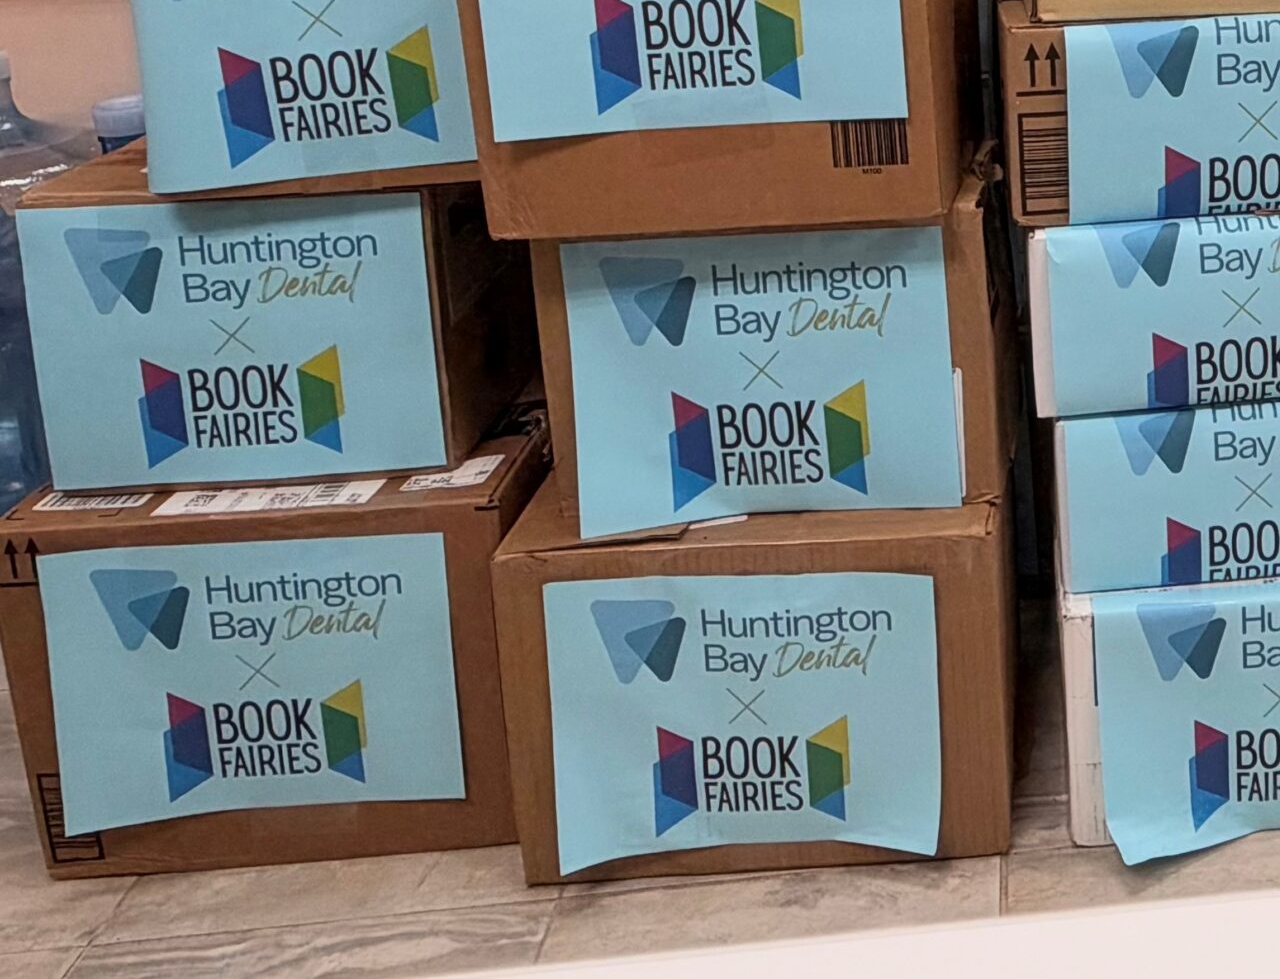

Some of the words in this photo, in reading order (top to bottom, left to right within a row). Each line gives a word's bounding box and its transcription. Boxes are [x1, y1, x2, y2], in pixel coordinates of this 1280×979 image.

[269, 48, 384, 104] BOOK
[647, 49, 755, 90] FAIRIES
[279, 98, 391, 142] FAIRIES
[178, 231, 377, 269] Huntington
[1200, 243, 1263, 280] Bay
[183, 273, 251, 309] Bay
[258, 261, 362, 303] Dental
[711, 261, 908, 300] Huntington
[715, 304, 781, 342] Bay
[787, 293, 891, 336] Dental
[187, 364, 293, 412] BOOK
[193, 410, 297, 448] FAIRIES
[717, 400, 819, 449] BOOK
[722, 449, 823, 486] FAIRIES
[1214, 431, 1276, 466] Bay
[205, 572, 402, 607] Huntington
[209, 611, 276, 646] Bay
[282, 599, 386, 640] Dental
[701, 607, 892, 642] Huntington
[704, 644, 767, 681] Bay
[773, 634, 876, 678] Dental
[213, 698, 316, 744] BOOK
[219, 742, 321, 778] FAIRIES
[702, 736, 800, 779] BOOK
[704, 780, 803, 812] FAIRIES
